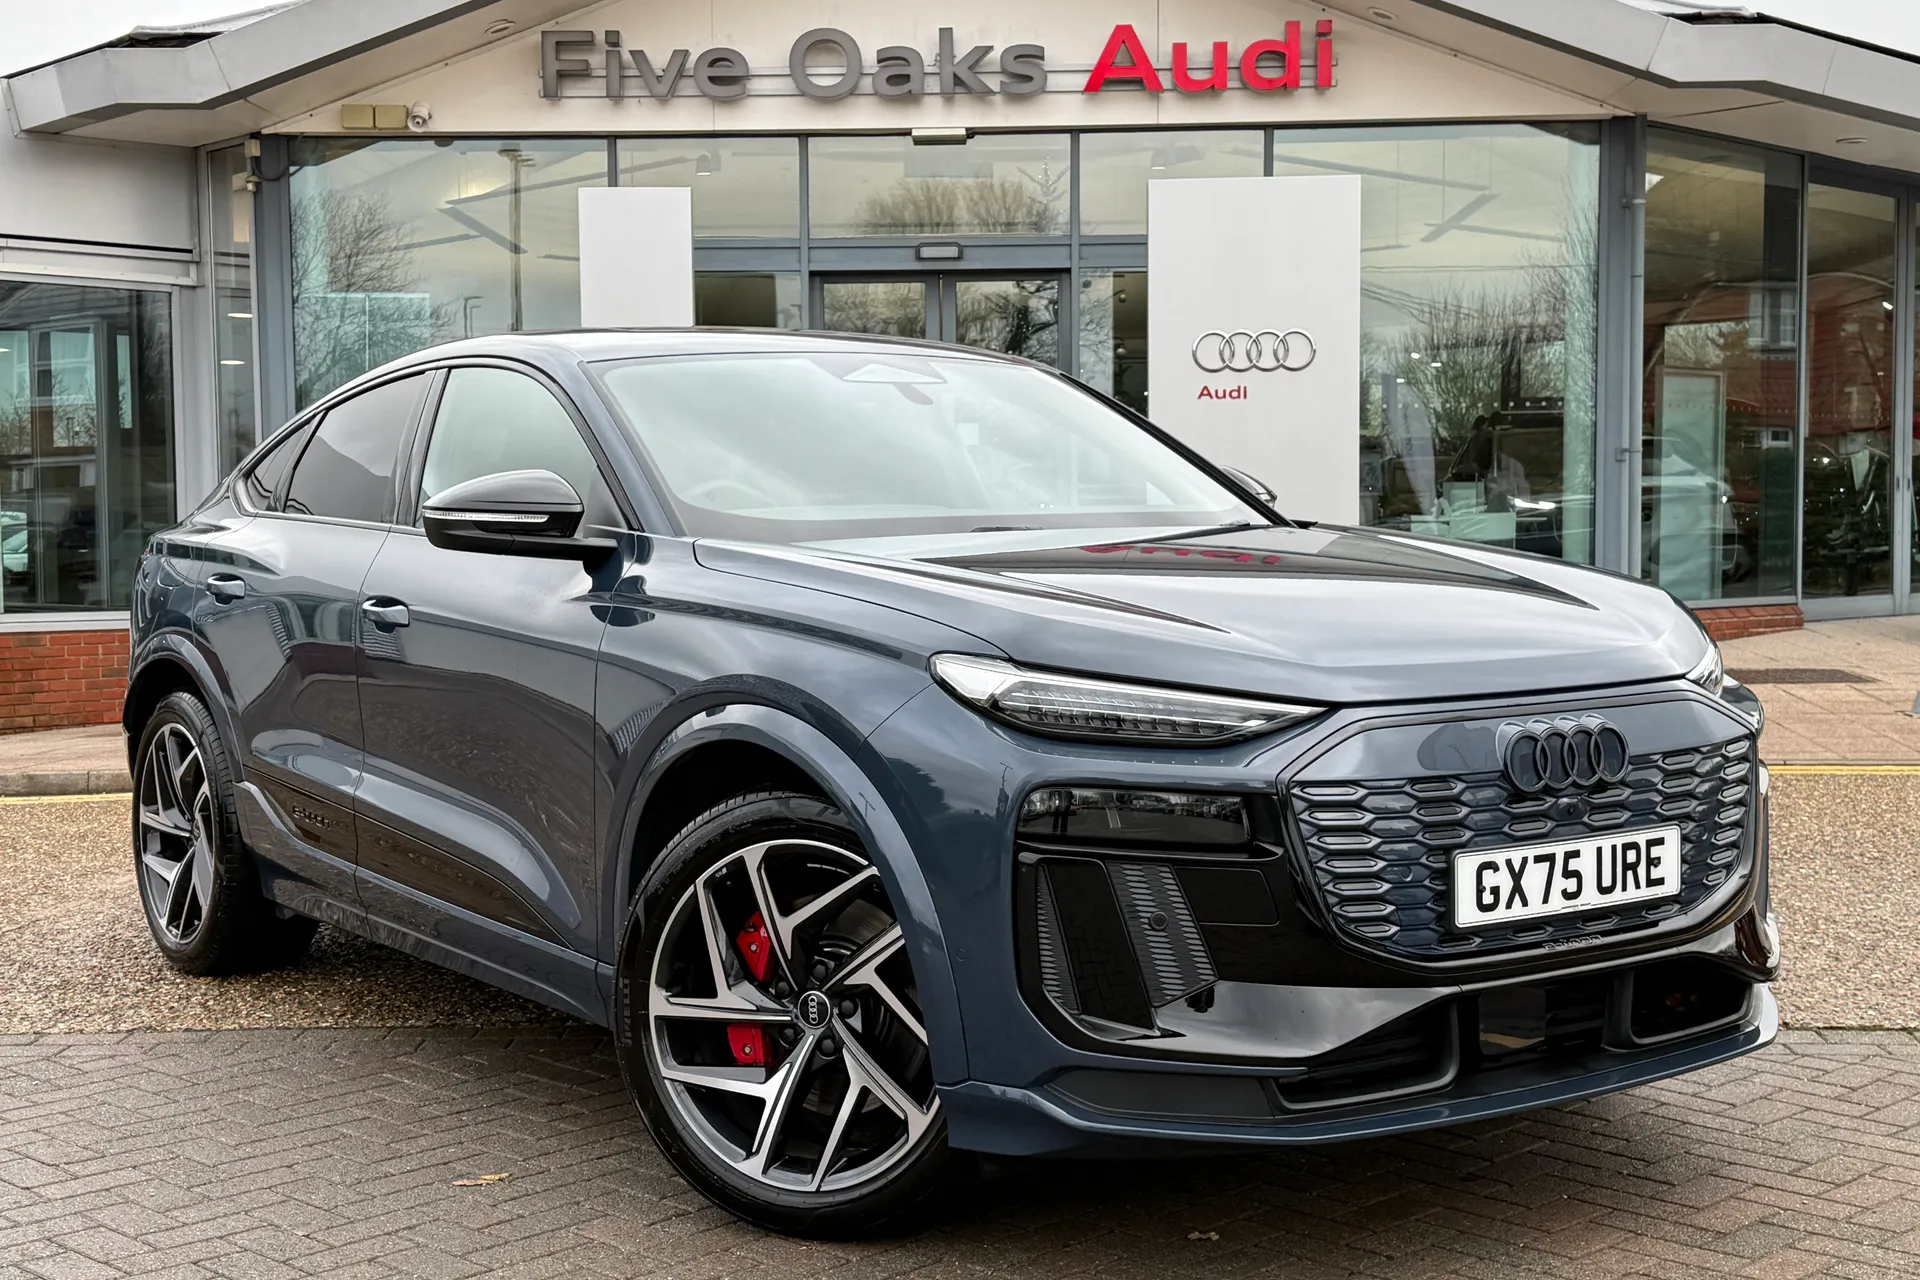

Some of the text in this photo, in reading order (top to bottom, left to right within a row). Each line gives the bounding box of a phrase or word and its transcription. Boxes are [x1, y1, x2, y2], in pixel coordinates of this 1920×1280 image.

[540, 20, 1334, 101] Five Oaks Audi
[1197, 385, 1248, 400] Audi
[1475, 836, 1666, 913] GX75 URE
